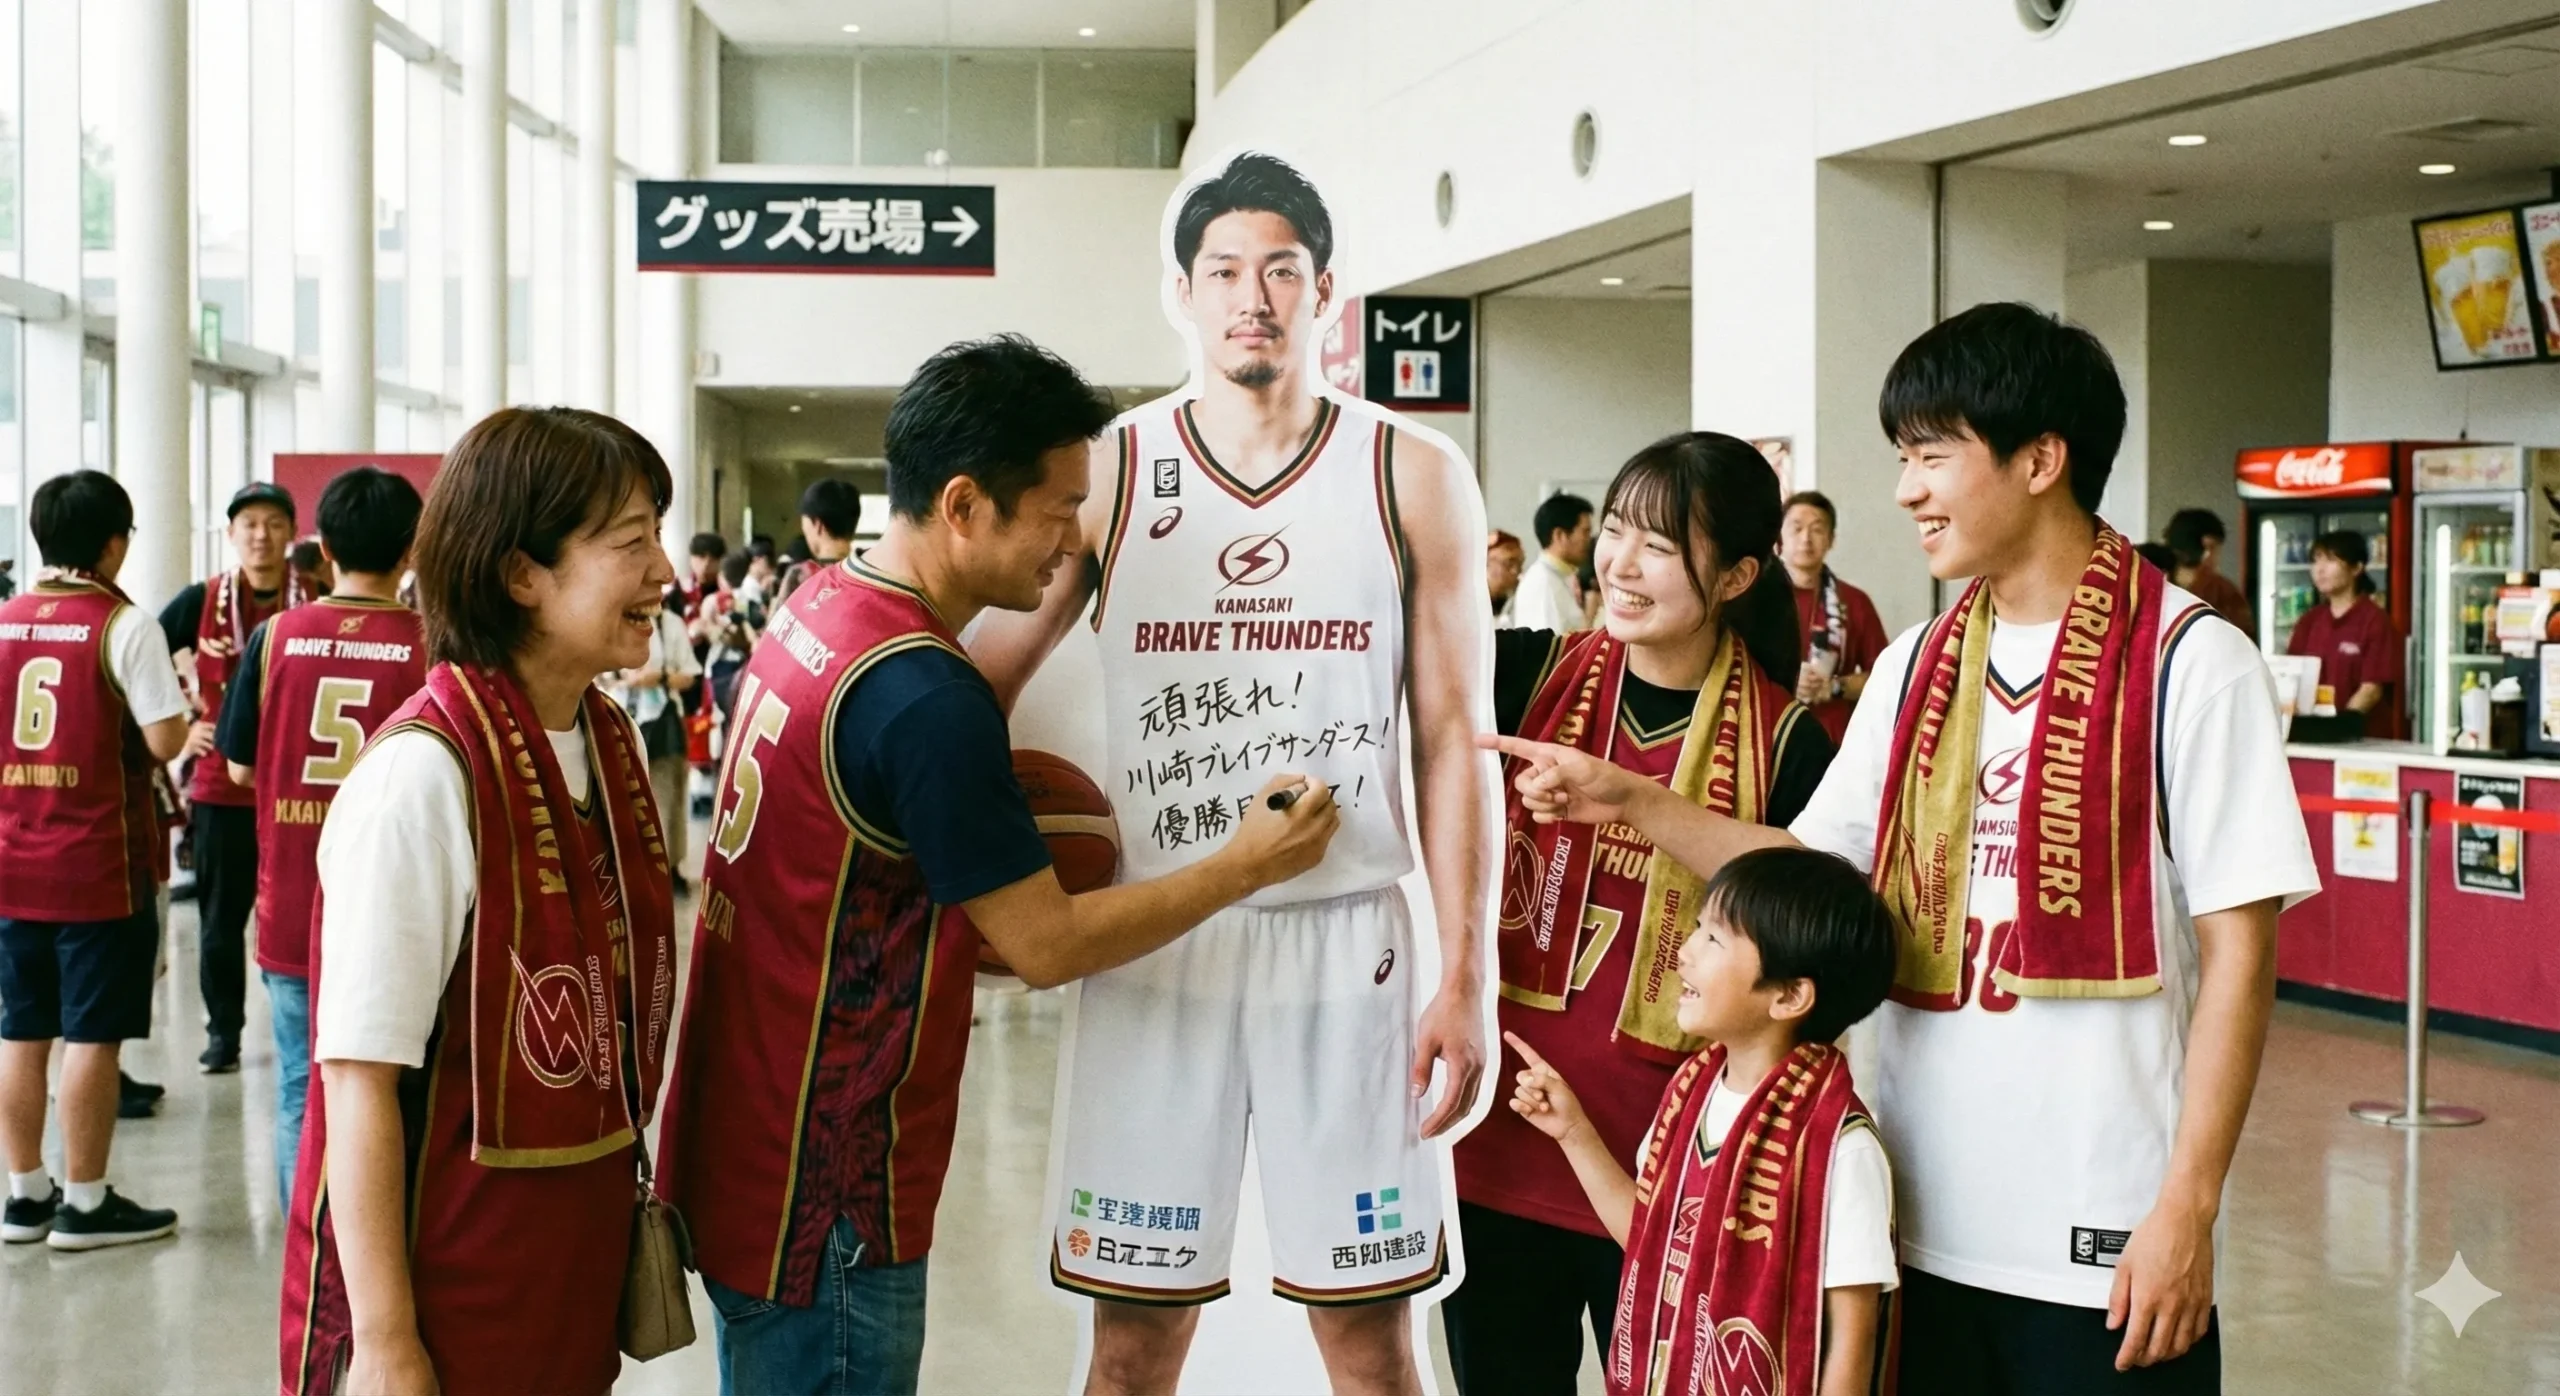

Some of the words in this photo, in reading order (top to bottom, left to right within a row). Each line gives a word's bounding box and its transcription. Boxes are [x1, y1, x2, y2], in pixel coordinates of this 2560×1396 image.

[655, 194, 926, 256] グッズ売場
[1373, 308, 1463, 343] トイレ
[1134, 621, 1223, 653] BRAVE
[1230, 619, 1374, 652] THUNDERS
[1214, 597, 1293, 614] KANASAKI
[284, 637, 336, 658] BRAVE
[335, 639, 412, 662] THUNDERS
[2052, 583, 2113, 707] BRAVE
[12, 656, 63, 751] 6
[301, 676, 374, 785] 5
[1138, 671, 1304, 741] 頑張れ！
[1127, 716, 1390, 796] 川崎ブレイブサンダース！
[2037, 713, 2088, 920] THUNDERS
[1569, 903, 1624, 991] 7
